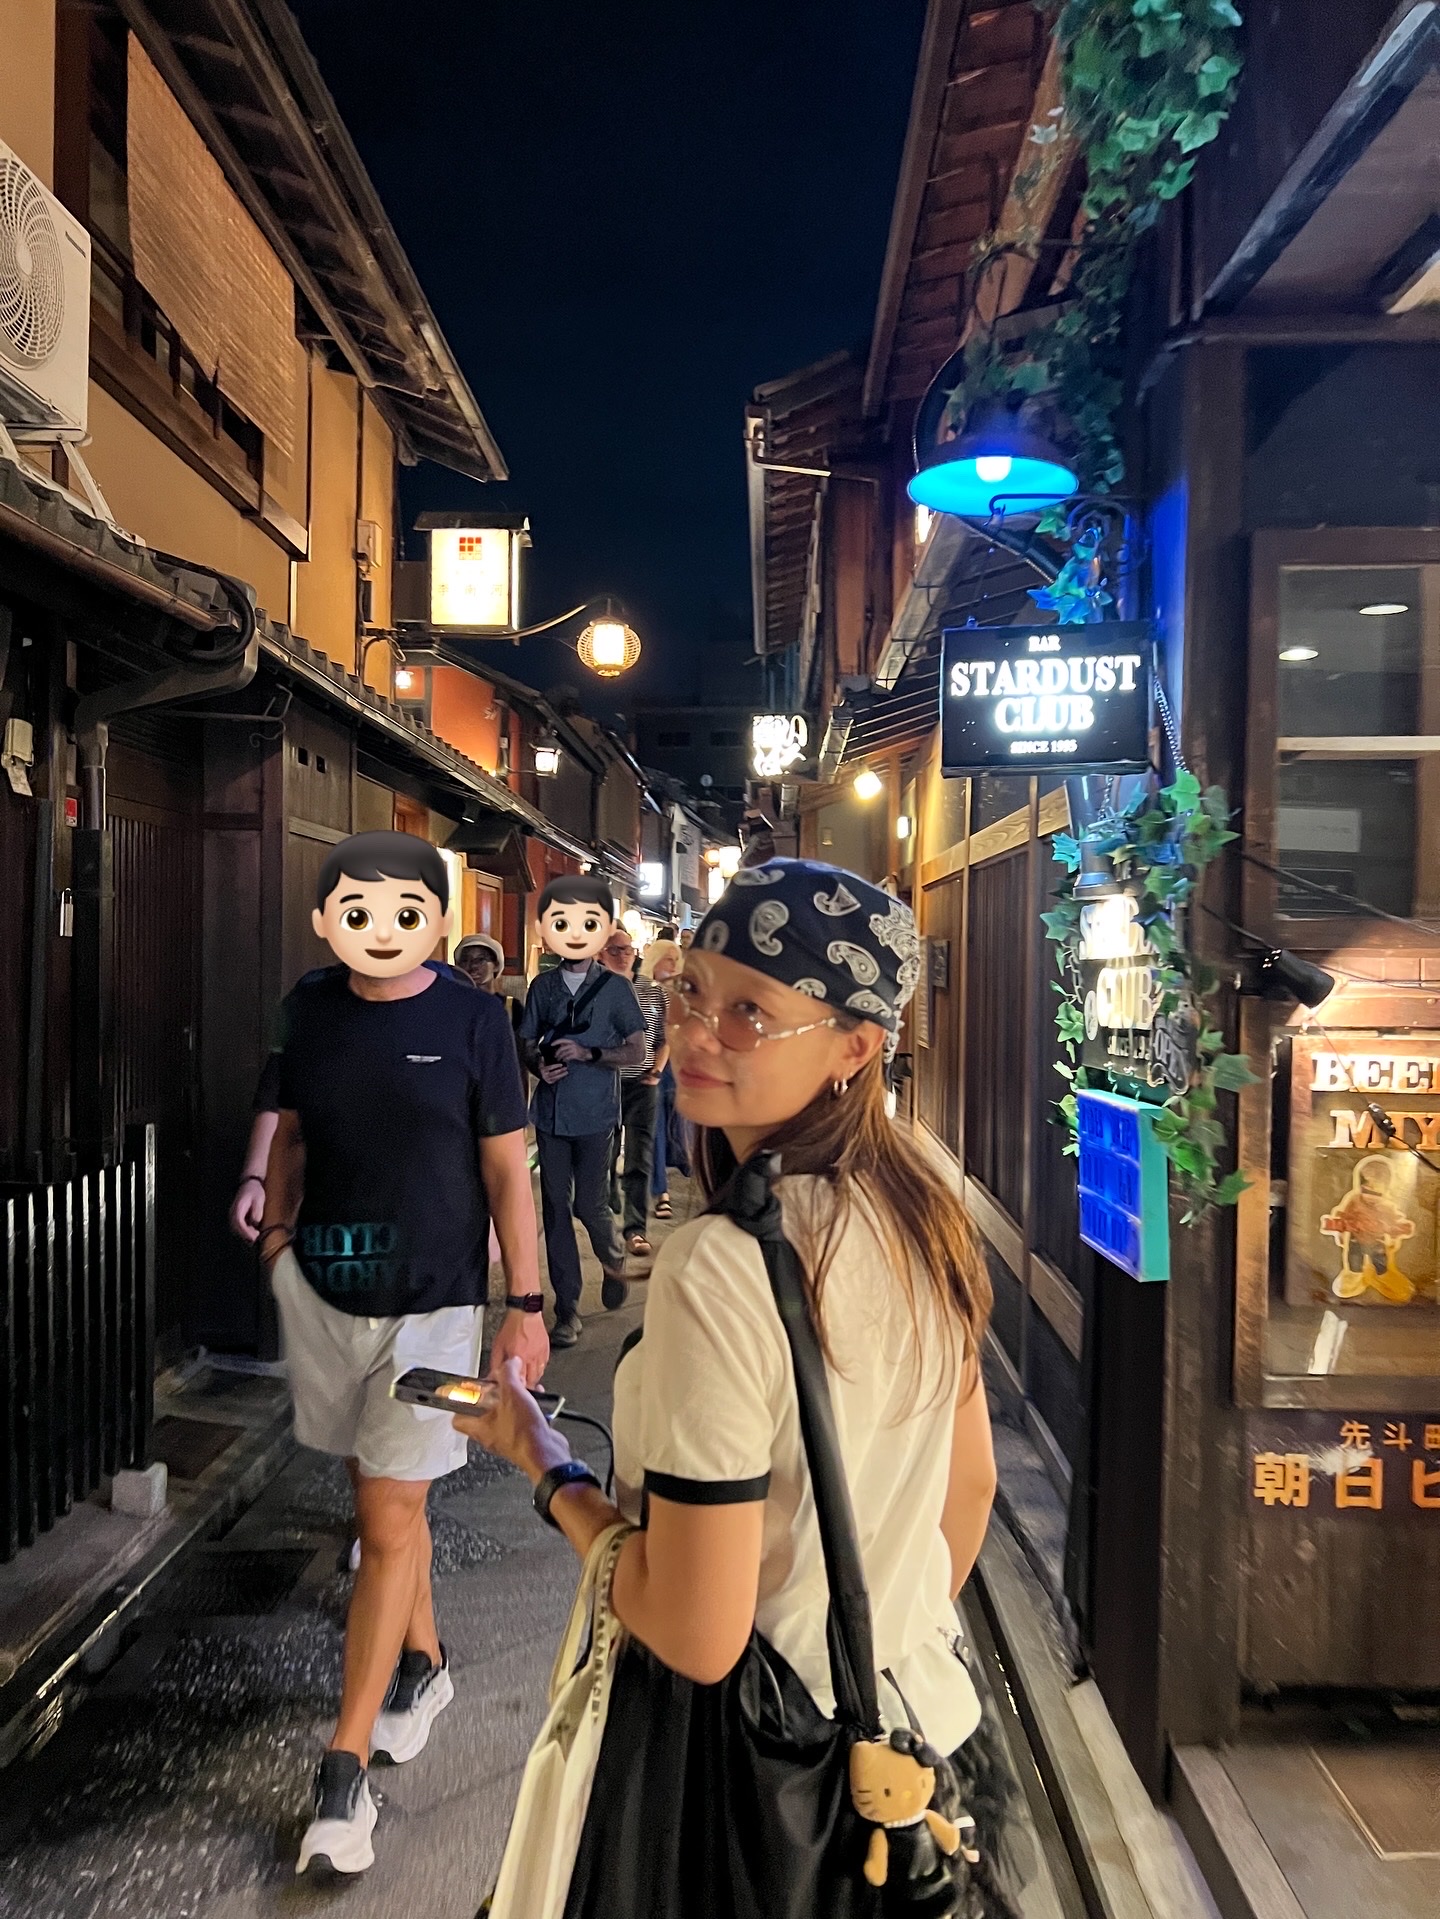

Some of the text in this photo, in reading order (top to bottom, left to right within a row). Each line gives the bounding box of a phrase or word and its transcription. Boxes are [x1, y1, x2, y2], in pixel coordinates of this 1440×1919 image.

[1029, 636, 1061, 652] BAR
[951, 655, 1141, 696] STARDUST
[995, 695, 1095, 733] CLUB
